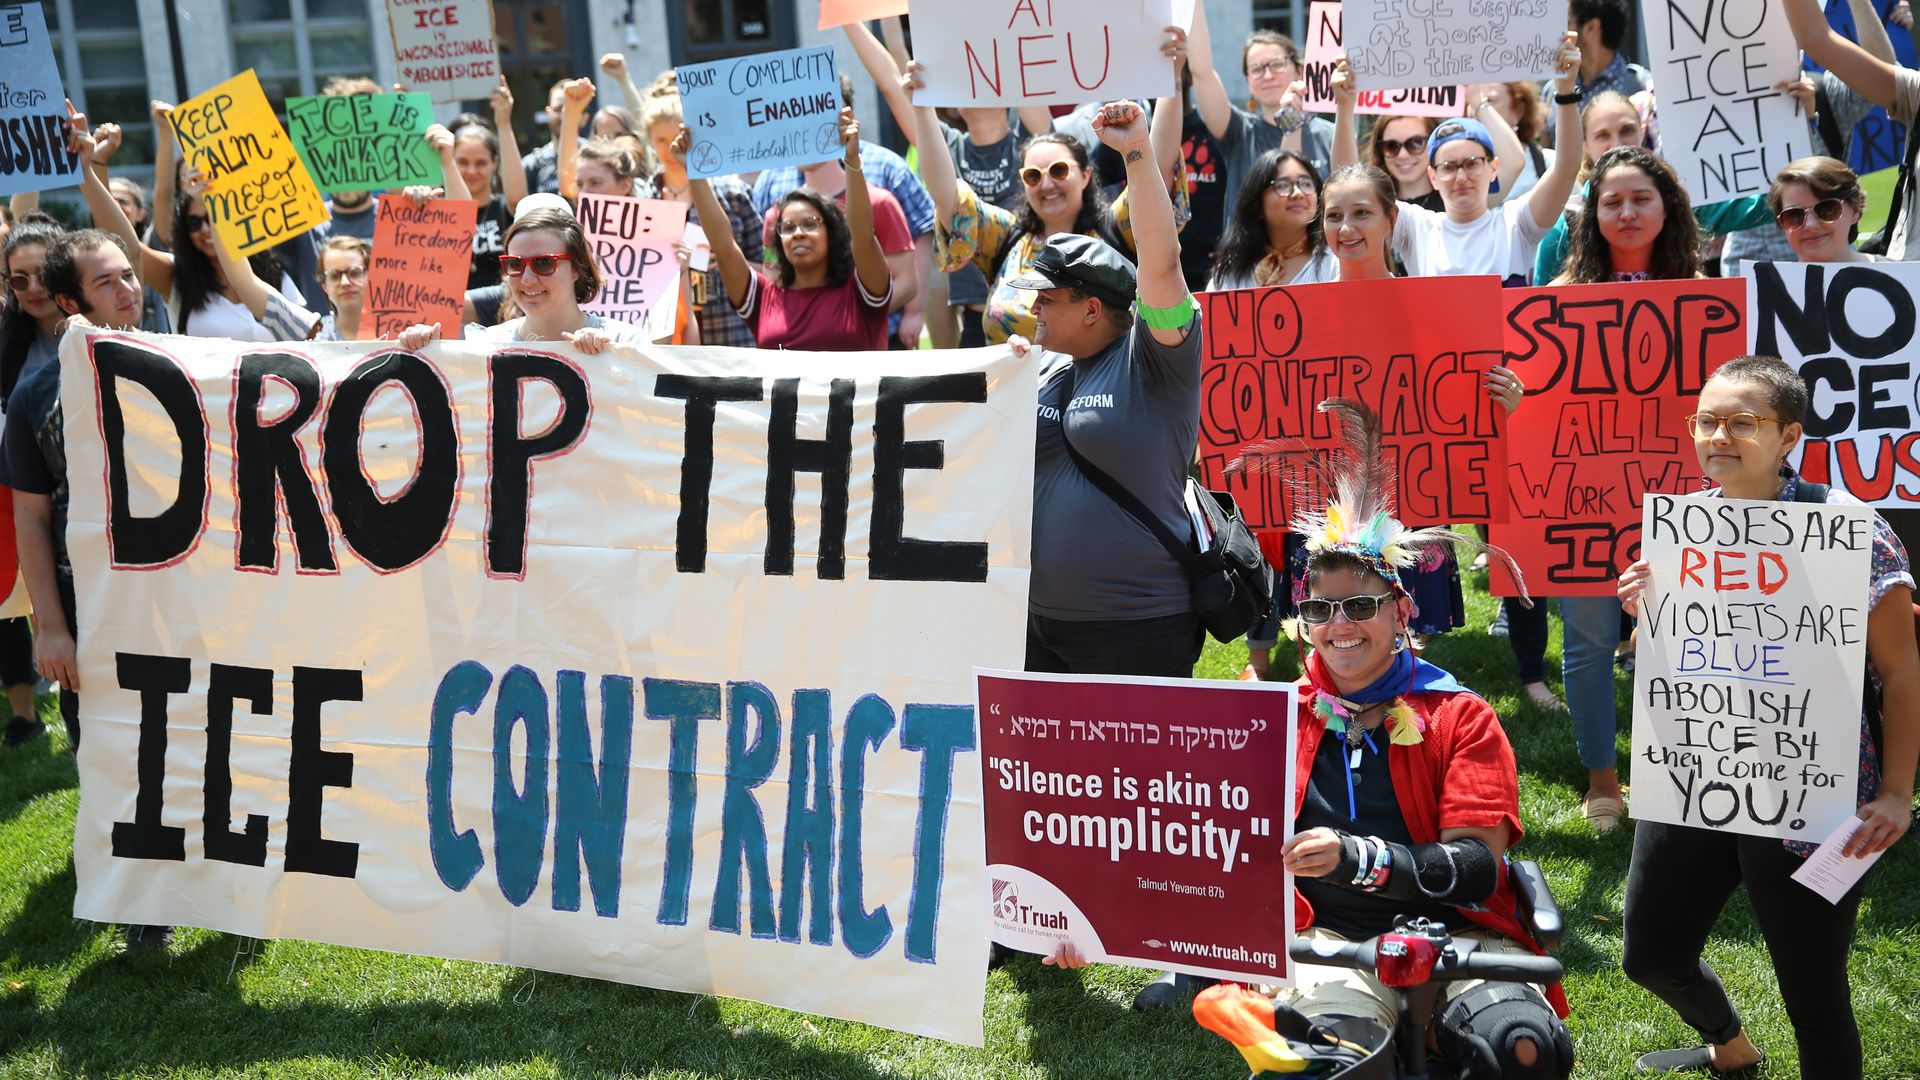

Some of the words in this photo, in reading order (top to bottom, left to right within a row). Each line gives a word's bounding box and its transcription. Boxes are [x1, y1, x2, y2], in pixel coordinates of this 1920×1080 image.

[414, 6, 459, 28] ICE
[1667, 0, 1767, 50] NO
[965, 25, 1109, 98] NEU
[1668, 43, 1770, 104] ICE
[169, 94, 232, 152] KEEP
[289, 93, 378, 147] ICE
[1693, 93, 1781, 152] AT
[192, 133, 272, 179] CALM
[307, 133, 428, 186] WHACK
[1700, 143, 1793, 200] NEU
[235, 199, 307, 249] ICE
[375, 257, 408, 271] more
[420, 257, 444, 273] like
[588, 240, 663, 279] ROP
[601, 280, 645, 306] HE
[1754, 261, 1916, 359] NO
[1209, 288, 1302, 360] NO
[1501, 294, 1740, 395] STOP
[1200, 350, 1504, 447] CONTRACT
[1800, 357, 1911, 438] CE
[1552, 397, 1678, 457] ALL
[86, 334, 594, 582] DROP
[654, 371, 989, 582] THE
[1653, 496, 1793, 547] ROSES
[1801, 511, 1867, 552] ARE
[1680, 547, 1789, 595] RED
[1642, 593, 1788, 641] VIOLETS
[1795, 605, 1861, 647] ARE
[1677, 638, 1789, 677] BLUE
[1648, 677, 1811, 727] ABOLISH
[1070, 720, 1160, 745] כהודאה
[1674, 717, 1758, 754] ICE
[989, 756, 1103, 798] "Silence
[1113, 767, 1138, 800] is
[1148, 771, 1211, 807] akin
[1220, 779, 1249, 811] to
[1642, 745, 1702, 779] they
[112, 652, 363, 879] ICE
[426, 660, 976, 964] CONTRACT
[1669, 769, 1807, 830] YOU!
[1023, 806, 1270, 873] complicity."
[1136, 876, 1168, 892] Talmud
[1169, 880, 1206, 897] Yevamot
[1208, 886, 1225, 899] 87b
[1020, 905, 1068, 931] T'ruah
[1169, 939, 1277, 968] www.truah.org
